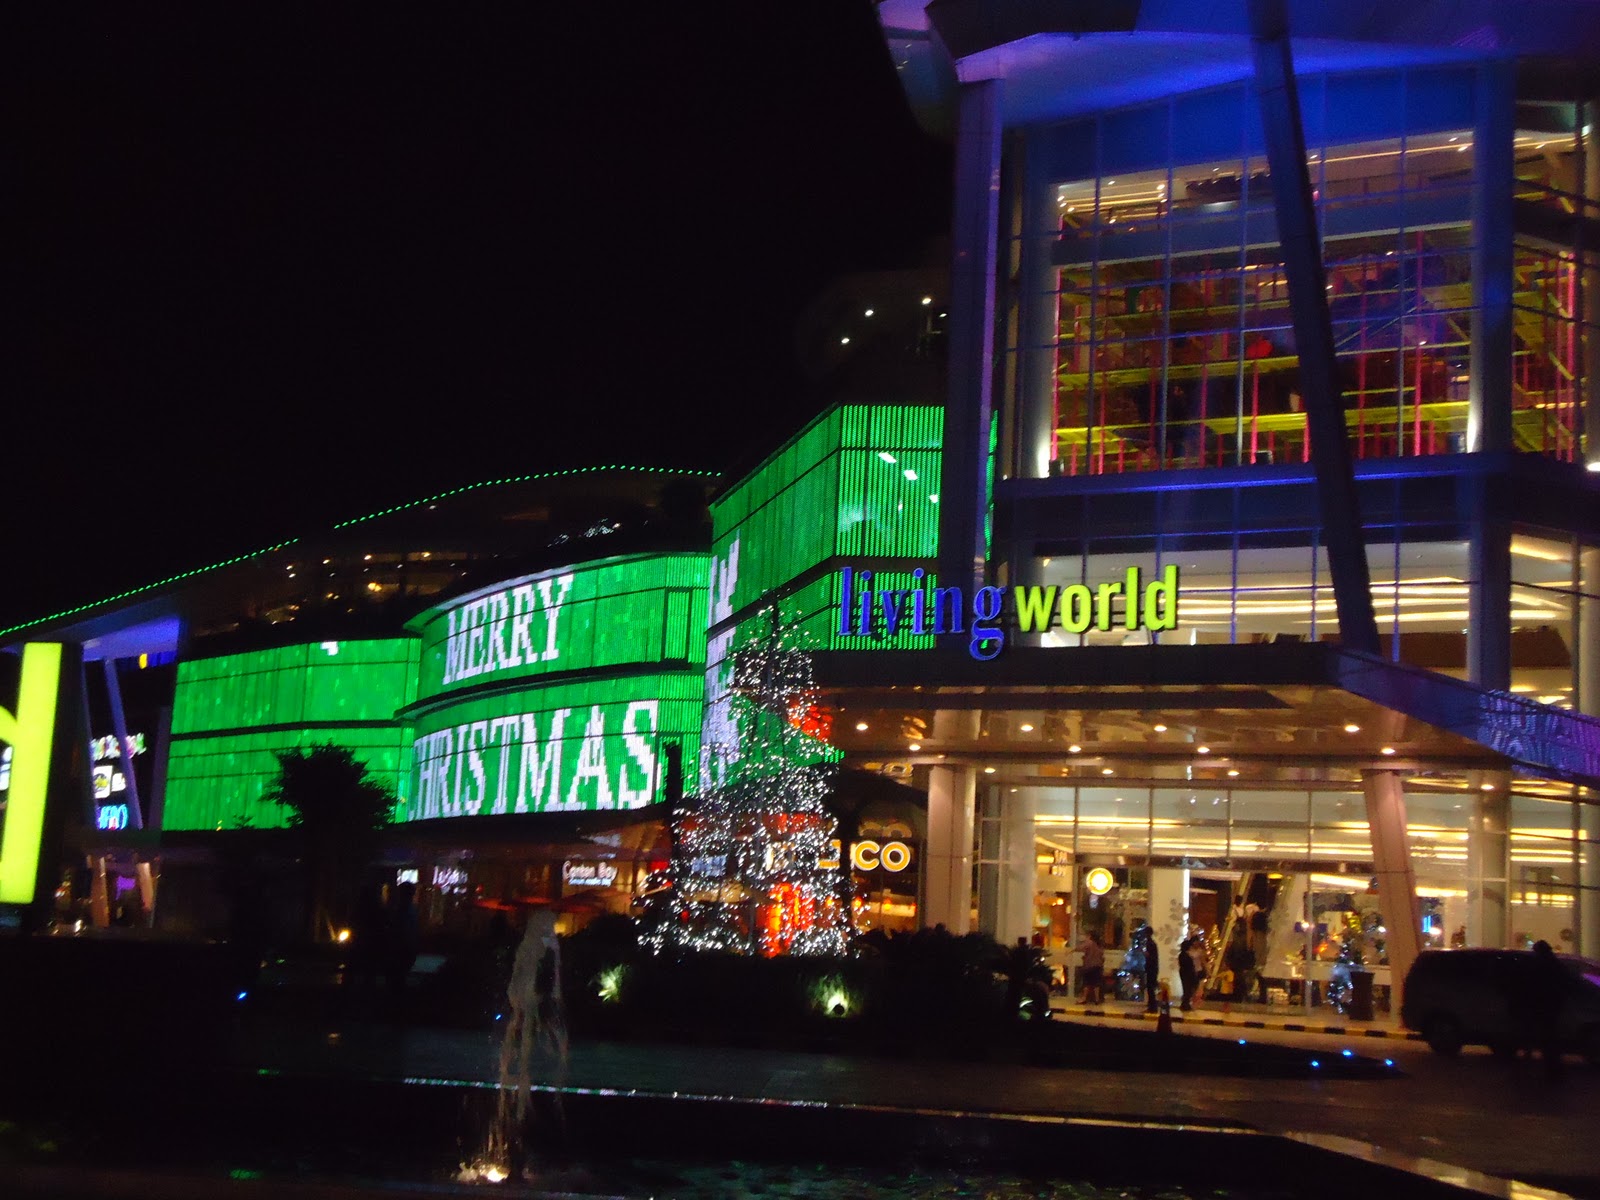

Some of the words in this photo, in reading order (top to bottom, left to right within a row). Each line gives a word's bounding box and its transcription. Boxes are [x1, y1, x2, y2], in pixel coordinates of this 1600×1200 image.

[443, 574, 574, 685] MERRY
[835, 566, 1007, 661] living
[1015, 564, 1177, 633] world
